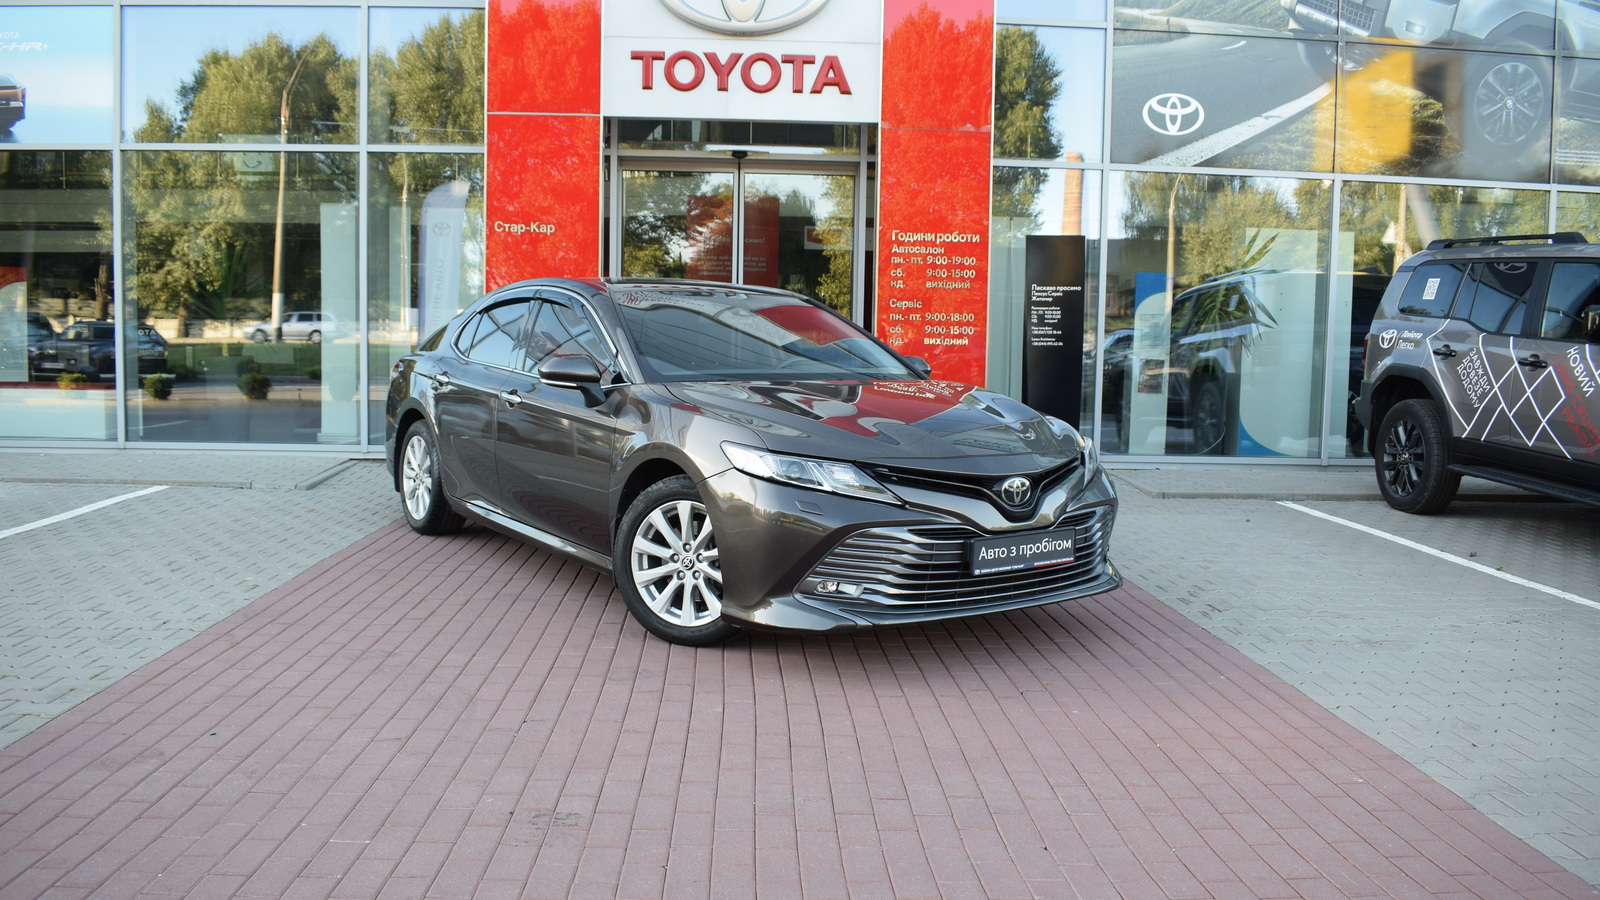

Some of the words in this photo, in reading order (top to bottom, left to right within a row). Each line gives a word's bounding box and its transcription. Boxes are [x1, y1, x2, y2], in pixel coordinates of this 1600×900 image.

[631, 50, 853, 95] TOYOTA
[494, 221, 556, 236] Стар-Кар
[891, 230, 935, 243] Години
[936, 231, 980, 244] роботи
[891, 244, 945, 254] Автосалон
[926, 255, 976, 266] 9:00-19:00
[890, 267, 906, 277] сб.
[926, 268, 976, 278] 9:00-15:00
[926, 280, 971, 289] вихідний
[889, 298, 923, 310] Сервіс
[925, 312, 975, 322] 9:00-18:00
[889, 325, 904, 334] сб.
[925, 325, 975, 335] 9:00-15:00
[889, 337, 904, 345] нд.
[924, 336, 969, 346] вихідний
[1462, 355, 1484, 397] ДОВЕЗЕ
[1469, 347, 1491, 393] ЗАВЖДИ
[1553, 355, 1576, 394] LAND
[1566, 345, 1596, 398] НОВИЙ
[1456, 363, 1481, 408] ДОДОМУ
[1561, 405, 1597, 457] PRADO
[979, 546, 1007, 561] Авто
[1009, 546, 1017, 557] з
[1019, 538, 1072, 558] пробігом
